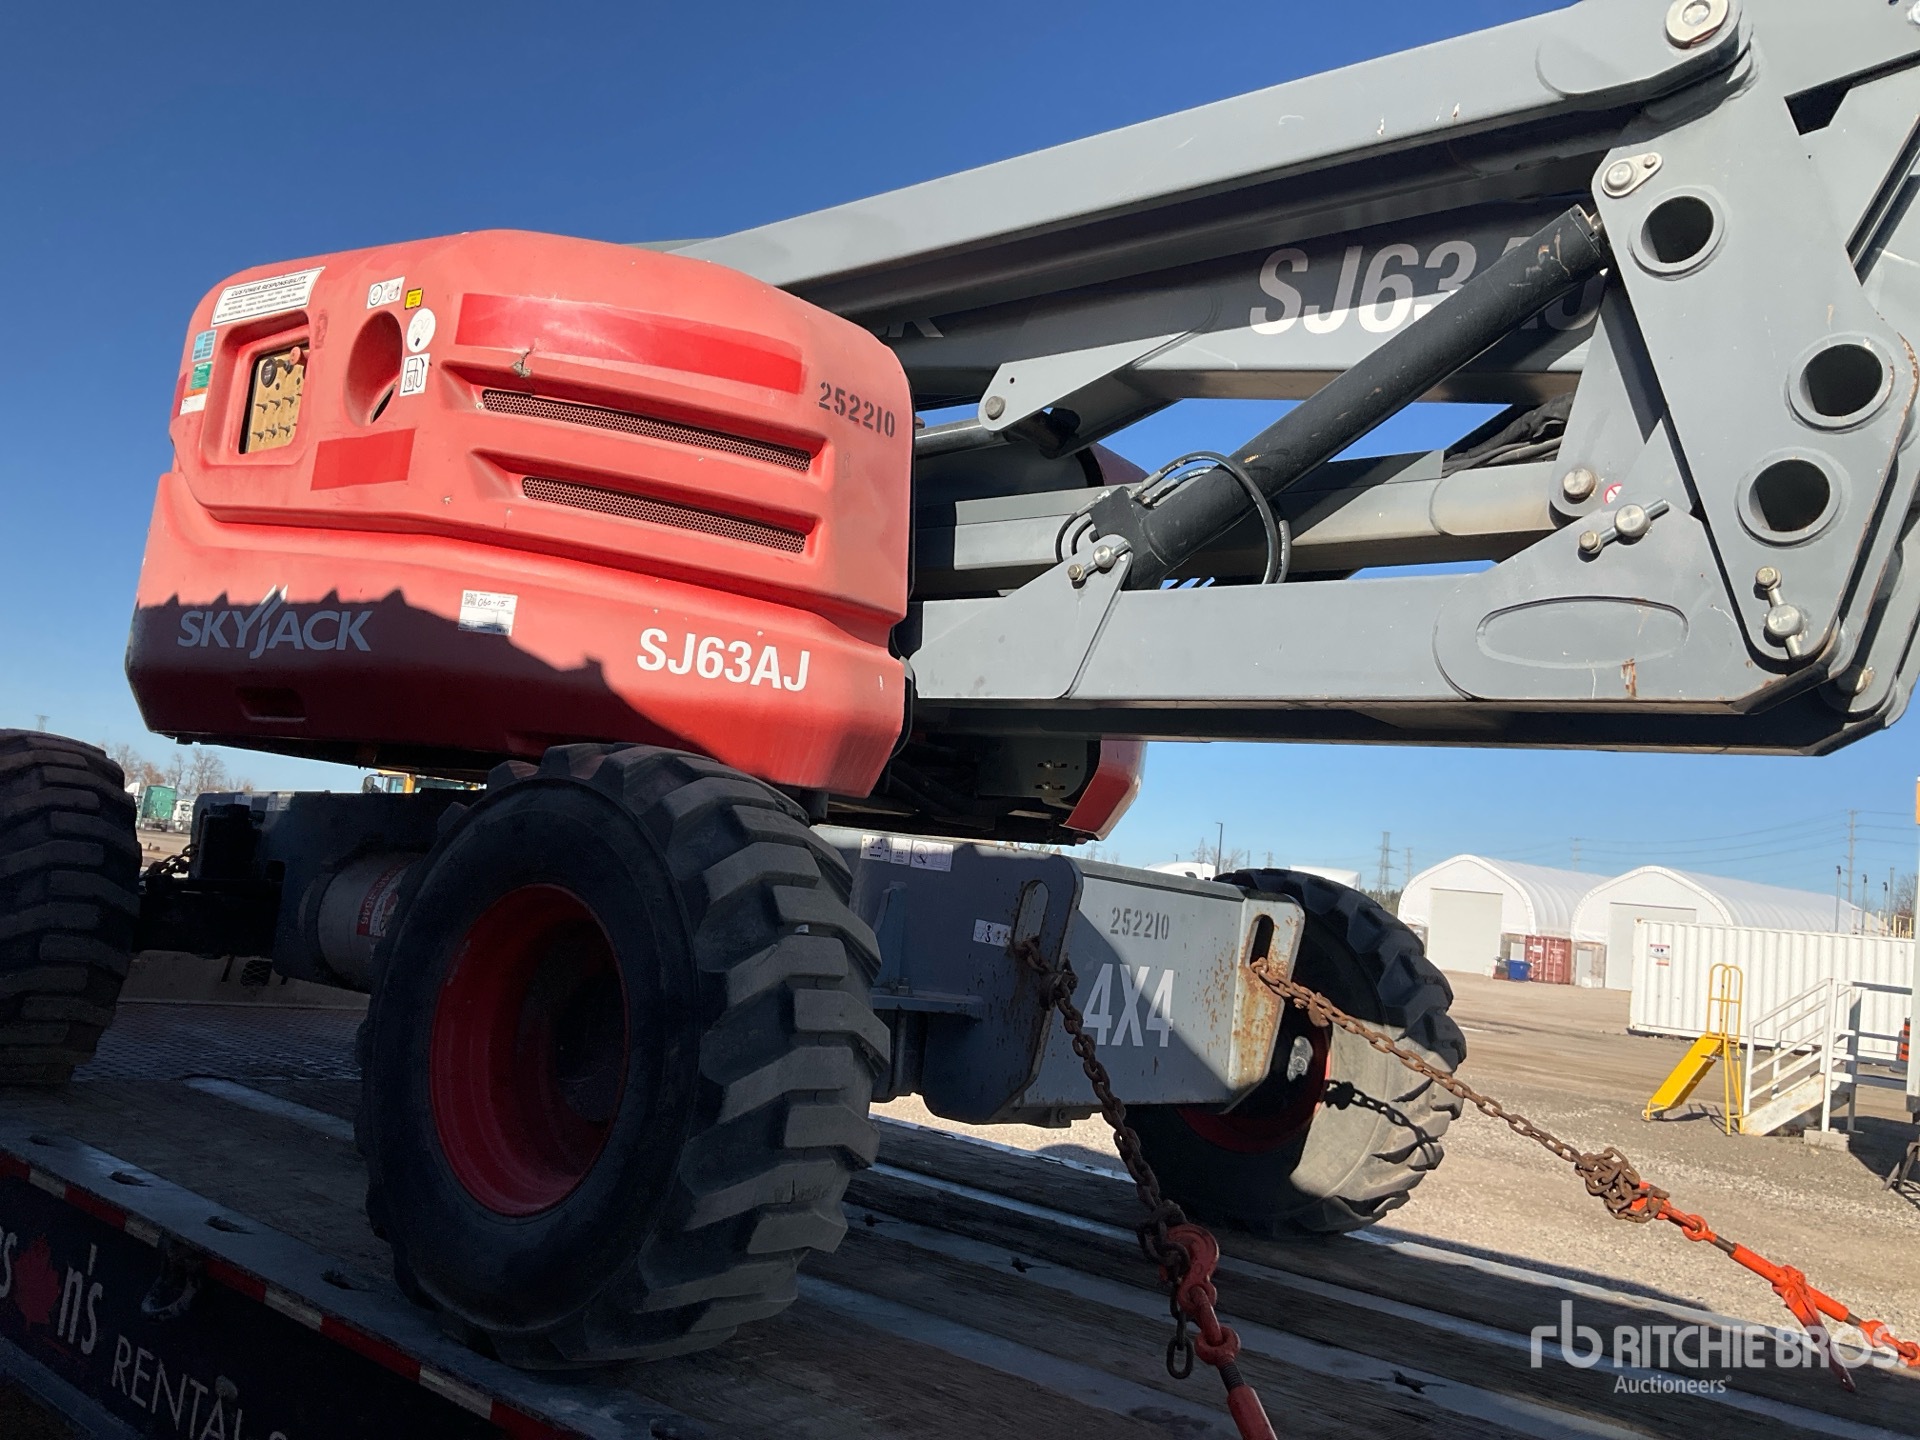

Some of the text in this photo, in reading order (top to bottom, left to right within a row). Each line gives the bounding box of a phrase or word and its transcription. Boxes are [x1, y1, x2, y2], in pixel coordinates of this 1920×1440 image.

[818, 381, 896, 438] 252210
[177, 583, 373, 660] SKYJACK
[637, 627, 811, 692] SJ63AJ
[1110, 907, 1170, 940] 252210
[1084, 964, 1174, 1048] 4X4
